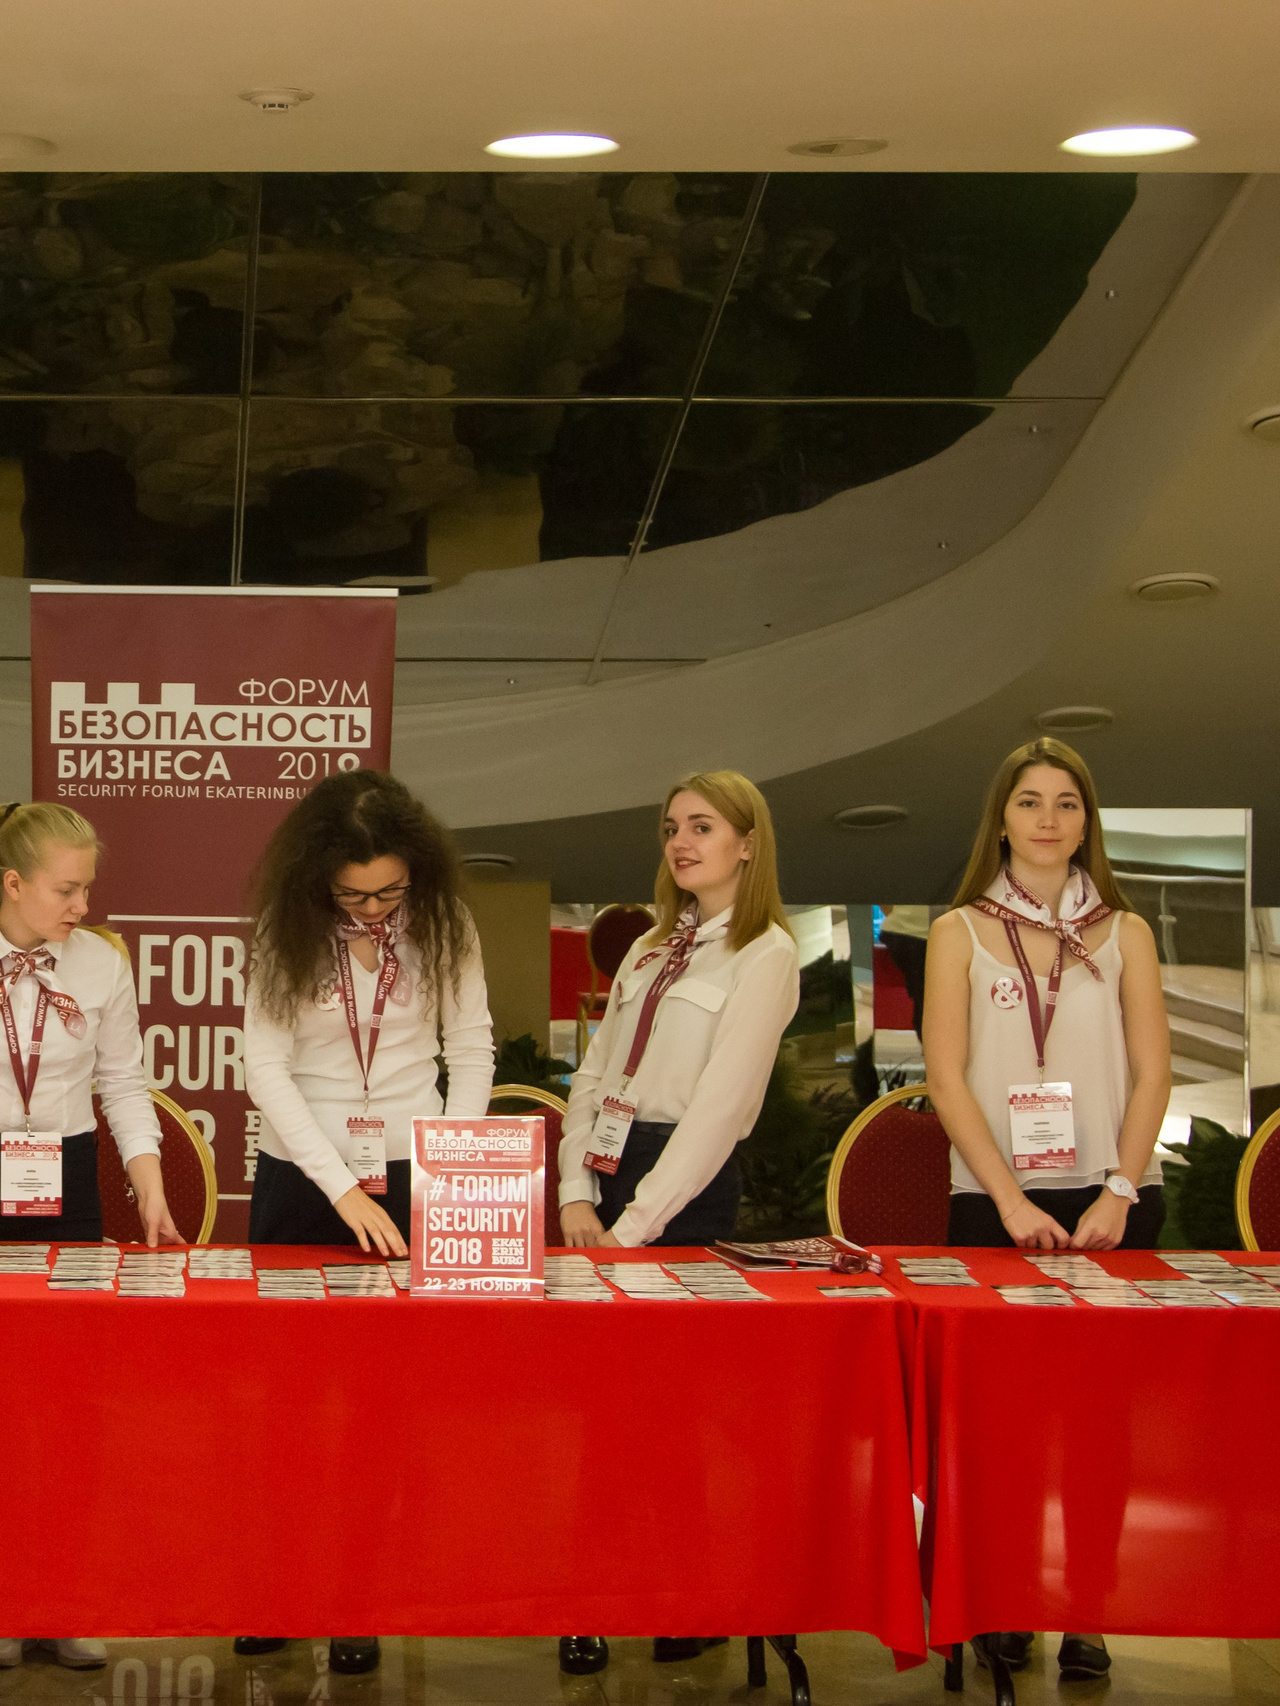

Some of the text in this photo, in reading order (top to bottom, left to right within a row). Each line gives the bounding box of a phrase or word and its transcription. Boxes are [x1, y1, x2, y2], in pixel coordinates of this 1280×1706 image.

[238, 677, 370, 706] ФОРУМ
[58, 708, 367, 743] БЕЗОПАСНОСТЬ
[58, 749, 231, 781] БИЗНЕСА
[57, 783, 308, 801] SECURITY FORUM EKATERINBU
[7, 1027, 18, 1054] ФОРУМ
[486, 1128, 530, 1138] ФОРУМ
[427, 1138, 530, 1149] БЕЗОПАСНОСТЬ
[427, 1150, 485, 1162] БИЗНЕСА
[428, 1207, 526, 1232] SECURITY
[429, 1237, 482, 1264] 2018
[491, 1238, 525, 1247] EKAT
[491, 1247, 525, 1256] ERIN
[491, 1256, 525, 1265] BURG
[423, 1277, 531, 1292] 22-23 НОЯБРЯ
